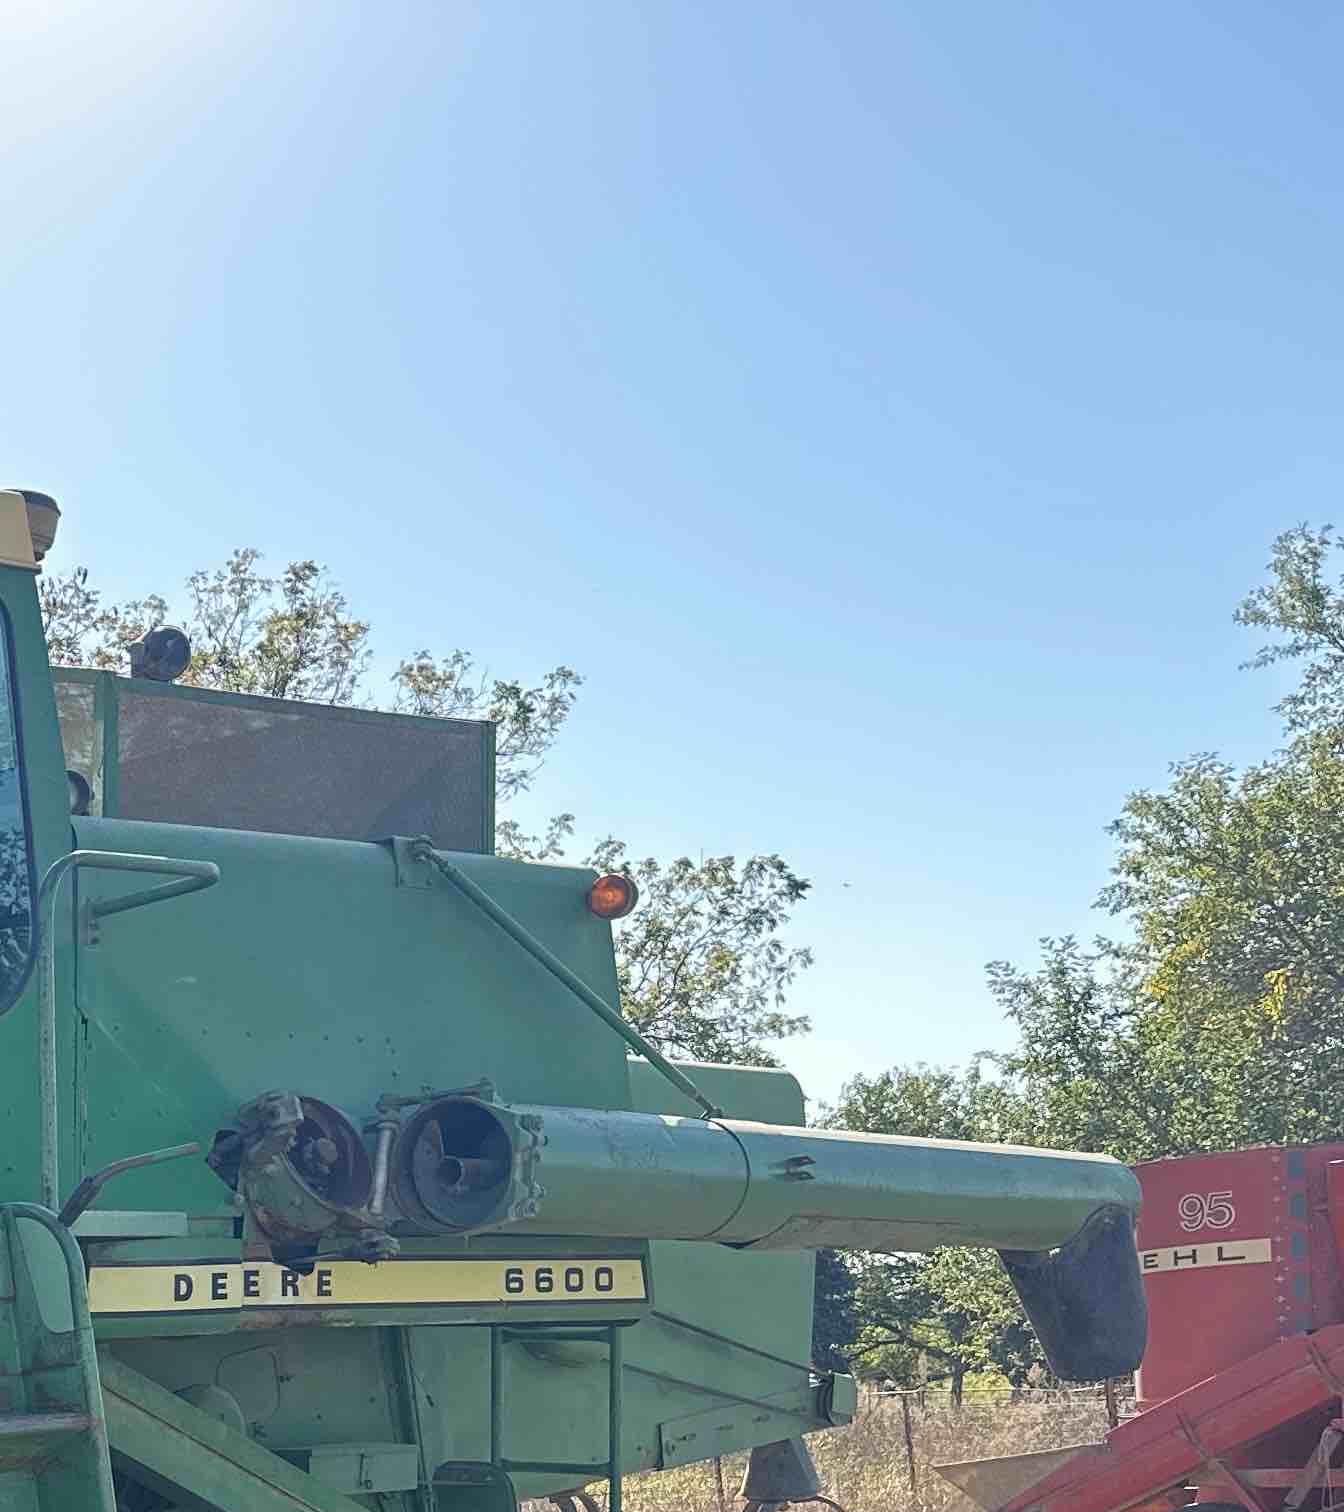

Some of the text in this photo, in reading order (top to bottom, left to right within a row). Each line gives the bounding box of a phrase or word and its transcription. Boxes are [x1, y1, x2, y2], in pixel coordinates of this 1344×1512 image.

[1178, 1190, 1236, 1232] 95
[174, 1266, 614, 1302] DEERE 6600
